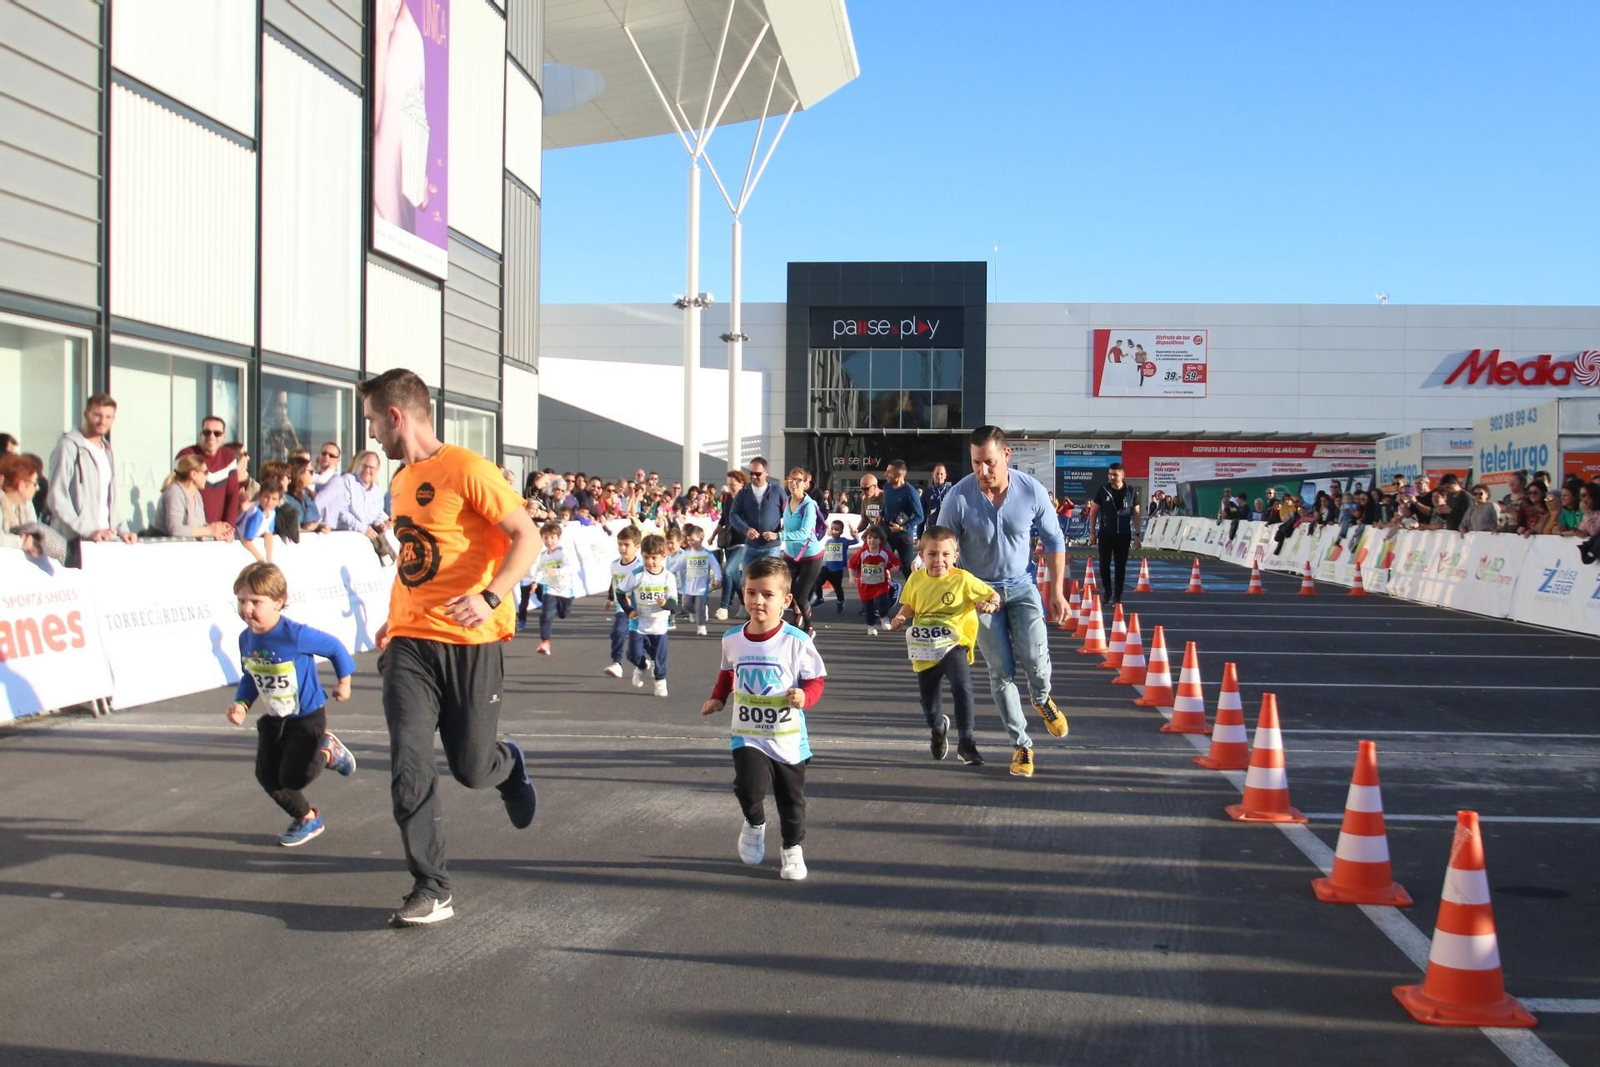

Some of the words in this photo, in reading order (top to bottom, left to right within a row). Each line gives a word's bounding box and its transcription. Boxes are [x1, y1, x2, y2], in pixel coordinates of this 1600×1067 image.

[1444, 349, 1575, 386] Media
[1490, 415, 1503, 432] 902
[1505, 412, 1514, 429] 88
[1516, 410, 1525, 427] 99
[1527, 407, 1537, 424] 43
[1480, 442, 1548, 476] telefurgo
[3, 593, 35, 609] SPORT
[44, 588, 79, 604] SHOES
[0, 610, 86, 660] anes
[911, 626, 952, 639] 8366
[738, 704, 792, 724] 8092
